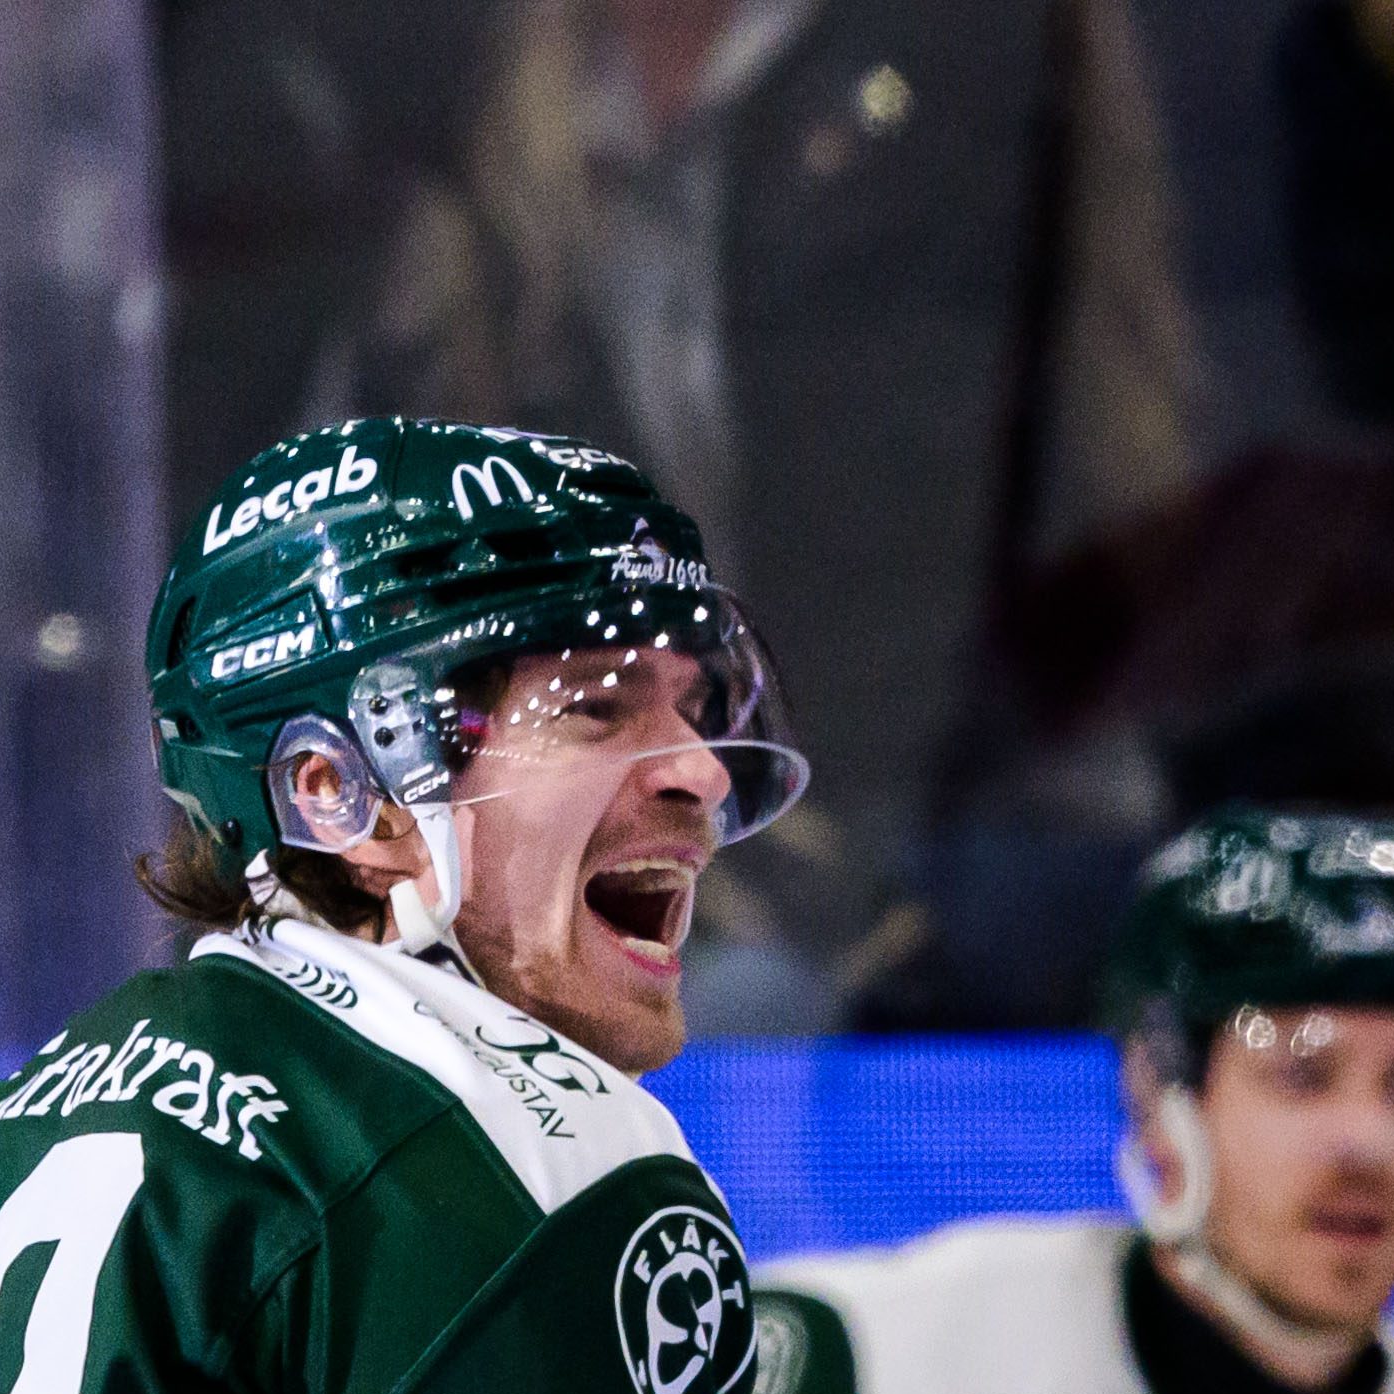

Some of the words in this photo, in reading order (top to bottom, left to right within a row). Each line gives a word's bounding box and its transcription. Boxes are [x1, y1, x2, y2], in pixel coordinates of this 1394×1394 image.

[202, 445, 378, 556] Lecab
[210, 622, 316, 679] CCM
[403, 770, 450, 803] CCM
